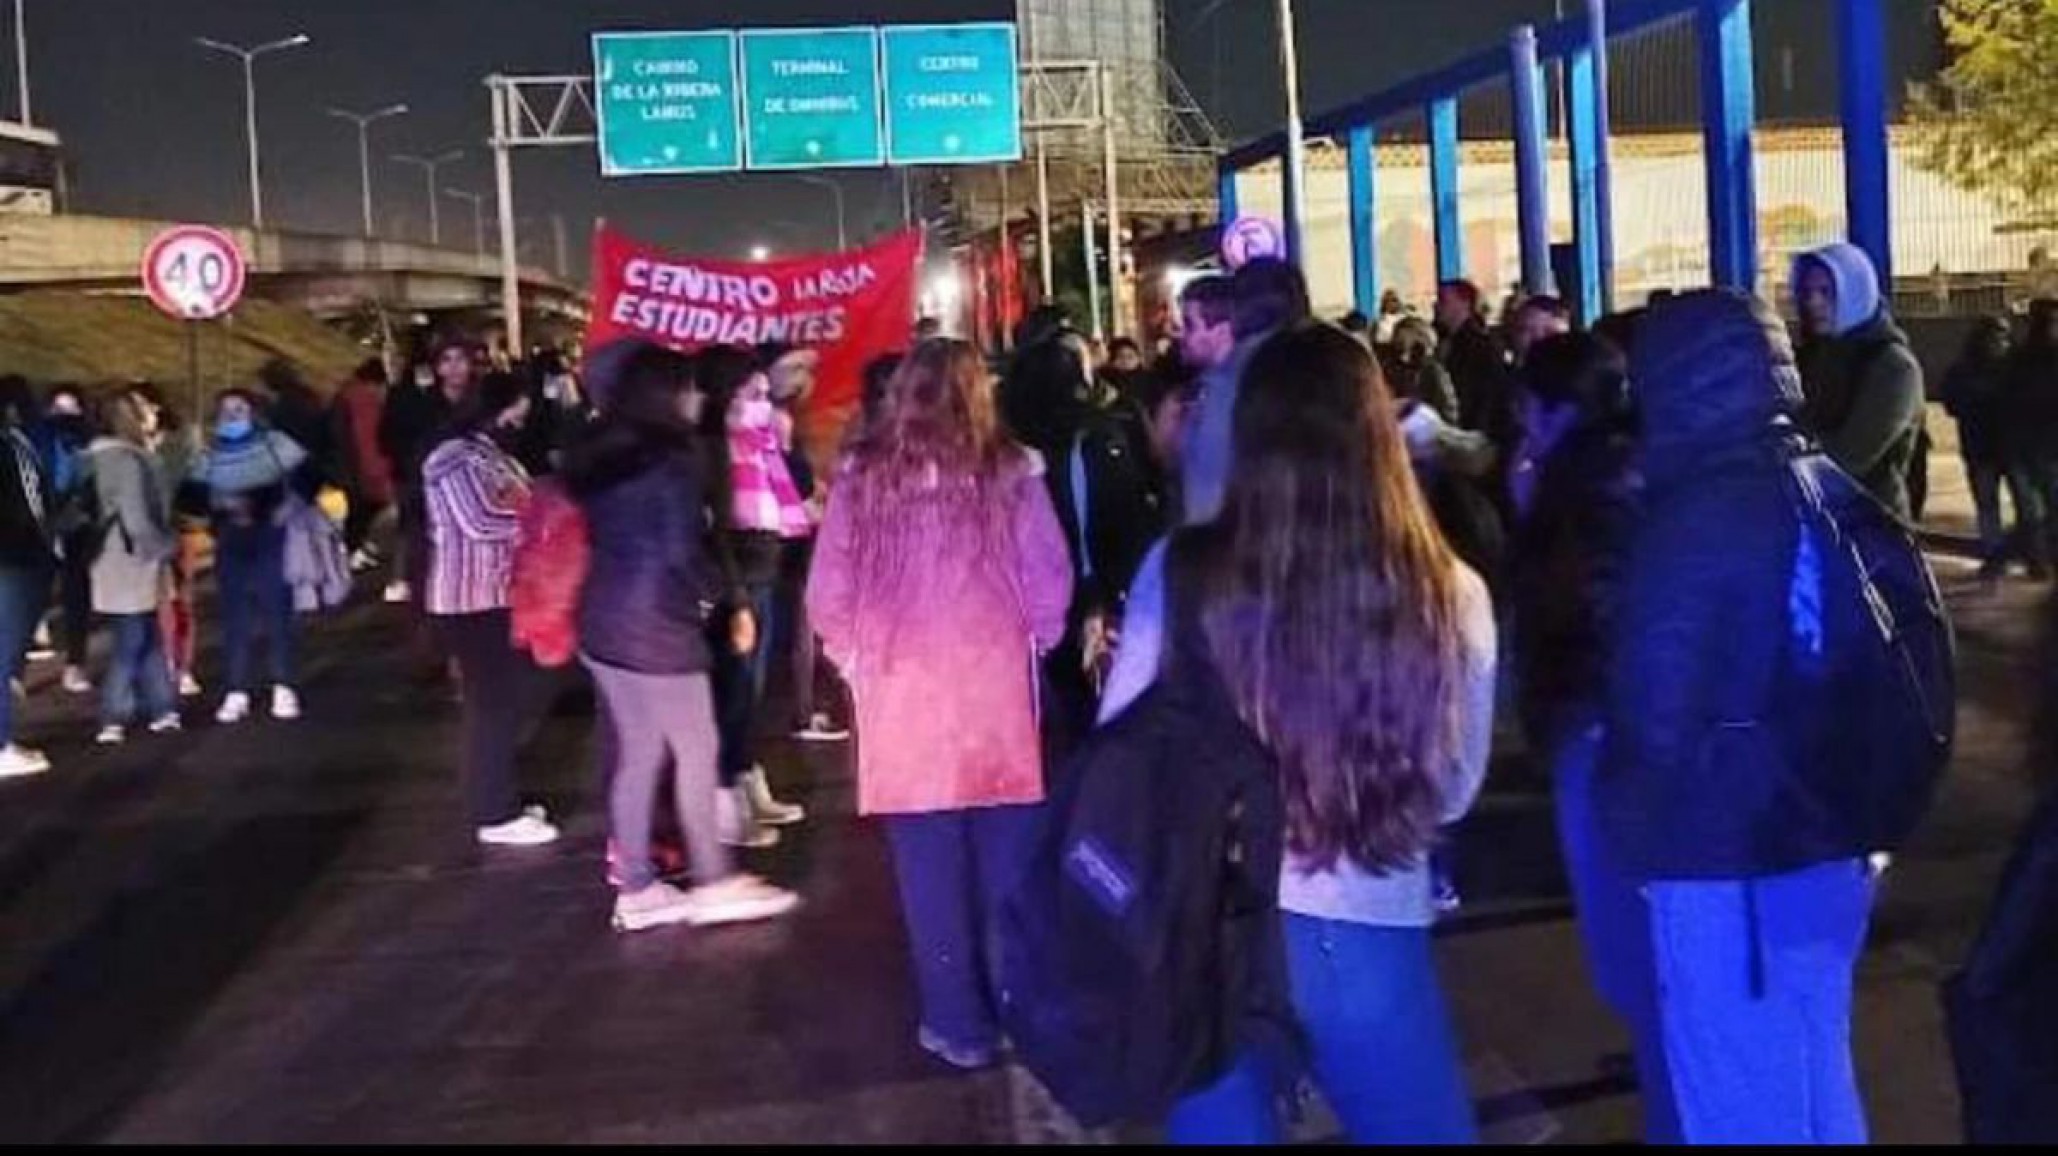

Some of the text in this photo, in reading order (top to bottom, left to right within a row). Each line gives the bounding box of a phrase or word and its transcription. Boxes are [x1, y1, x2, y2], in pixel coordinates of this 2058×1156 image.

[771, 59, 850, 76] TERMINAL
[612, 84, 634, 100] DE
[637, 84, 659, 99] LA
[764, 97, 784, 113] DE
[164, 252, 224, 294] 40
[624, 258, 778, 311] CENTRO
[610, 292, 846, 346] ESTUDIANTES
